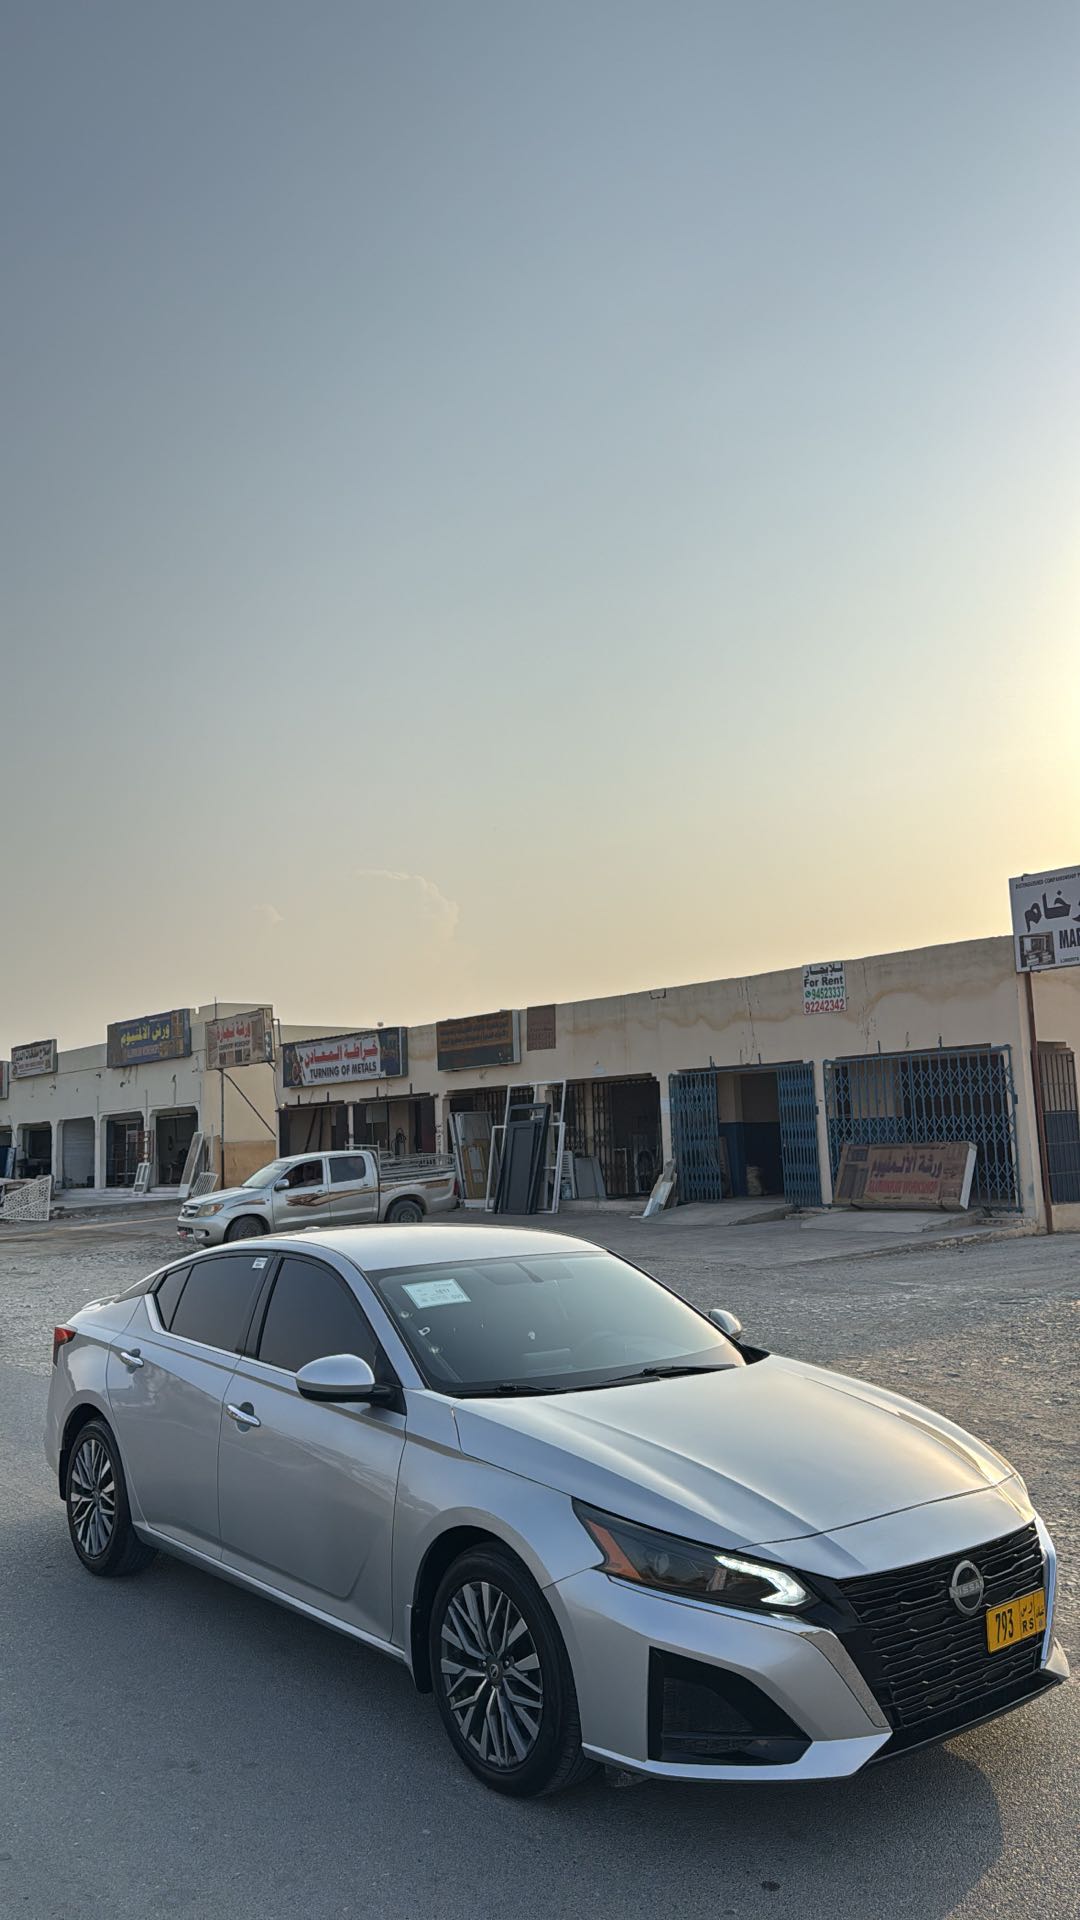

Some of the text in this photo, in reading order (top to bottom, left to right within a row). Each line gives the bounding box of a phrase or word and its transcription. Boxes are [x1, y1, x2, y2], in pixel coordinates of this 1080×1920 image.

[804, 976, 844, 988] For Rent
[811, 986, 845, 1000] 94523337
[805, 999, 845, 1013] 92242342
[304, 1044, 343, 1068] المعادن
[343, 1039, 378, 1061] خراطة
[309, 1061, 377, 1079] TURNING OF METALS
[995, 1608, 1014, 1643] 793
